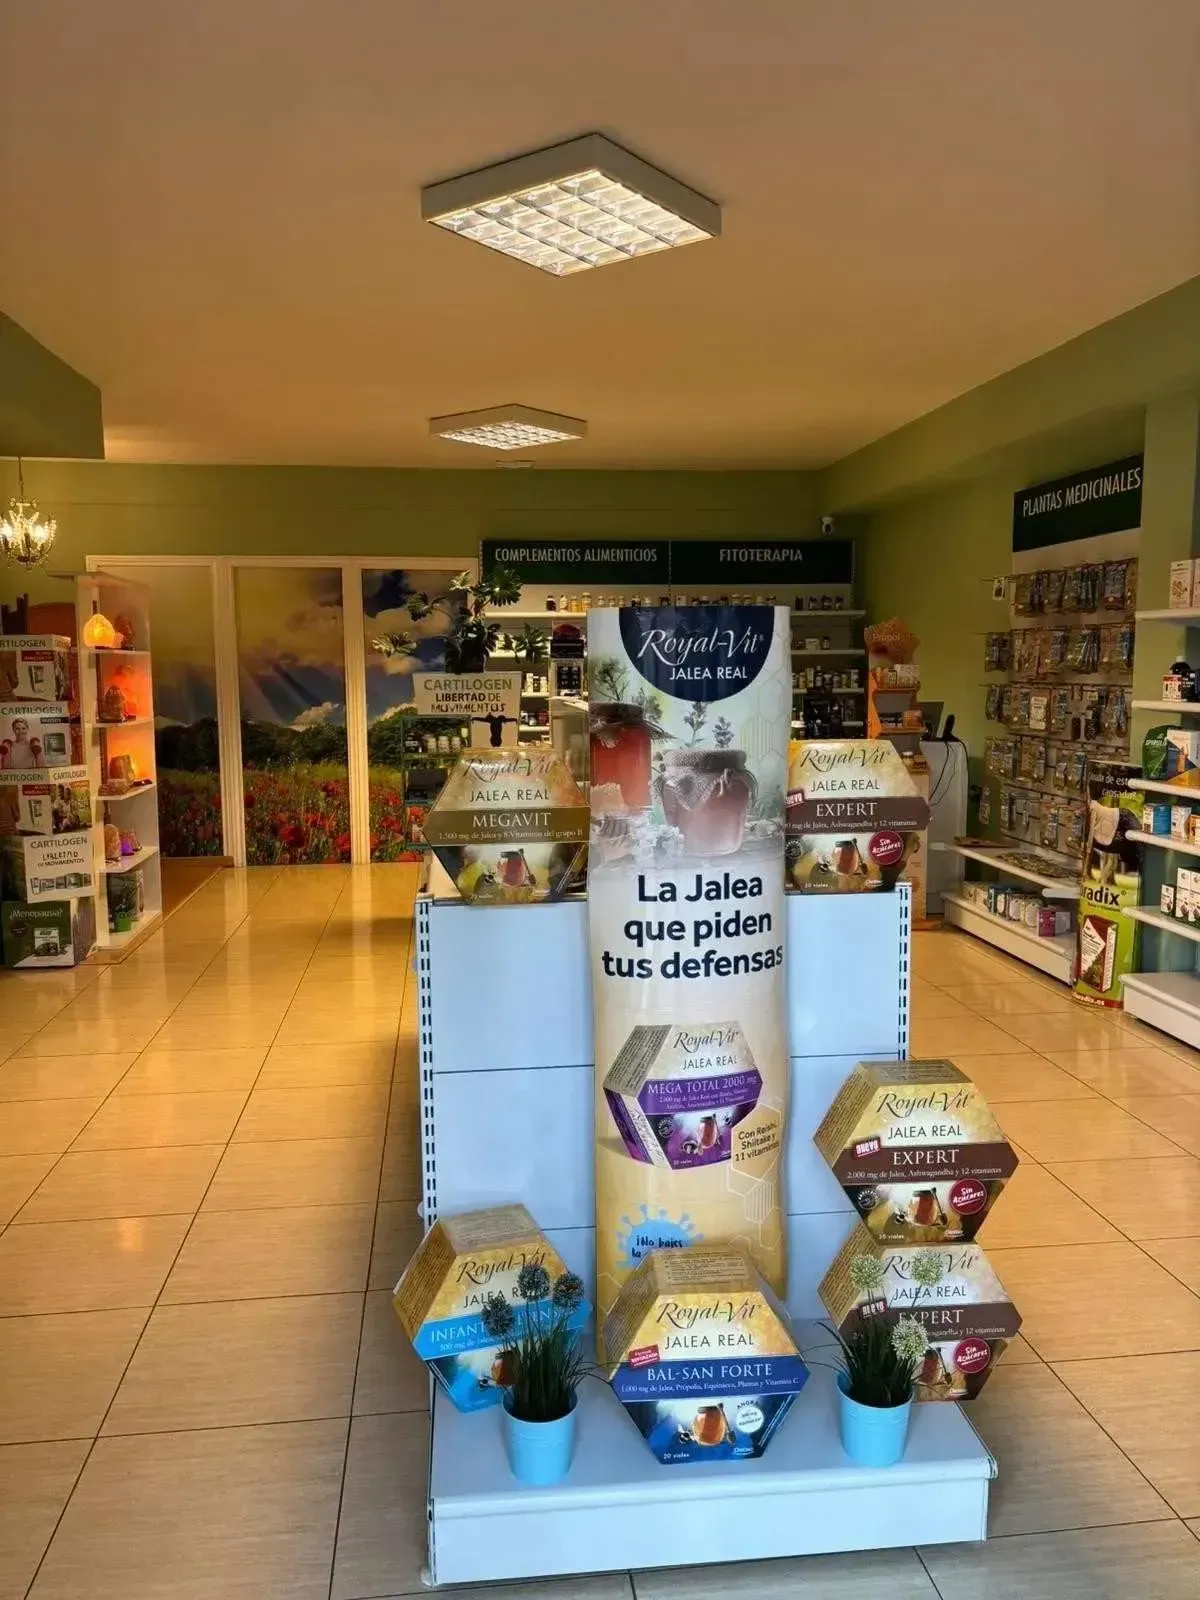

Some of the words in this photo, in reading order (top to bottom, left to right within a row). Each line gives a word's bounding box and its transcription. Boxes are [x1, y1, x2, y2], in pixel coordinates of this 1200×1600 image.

[1022, 489, 1063, 518] PLANTAS
[1065, 467, 1142, 506] MEDICINALES
[494, 547, 582, 563] COMPLEMENTOS
[584, 547, 658, 563] ALIMENTICIOS
[718, 548, 804, 563] FITOTERAPIA
[669, 666, 713, 682] JALEA
[716, 665, 749, 681] REAL
[423, 677, 513, 692] CARTILOGEN
[435, 692, 486, 703] LIBERTAD
[487, 692, 501, 703] DE
[1, 706, 63, 716] CARTILOGEN
[430, 702, 506, 714] MOVIMIENTOS
[810, 779, 848, 792] JALEA
[851, 778, 881, 791] REAL
[470, 790, 511, 803] JALEA
[516, 788, 550, 801] REAL
[815, 802, 879, 818] EXPERT
[472, 812, 552, 829] MEGAVIT
[30, 837, 88, 849] CARTILOGEN
[638, 874, 677, 903] La
[684, 872, 764, 903] Jalea
[623, 918, 686, 948] que
[693, 909, 772, 947] piden
[602, 949, 653, 980] tus
[660, 944, 784, 980] defensas
[682, 1055, 713, 1071] JALEA
[647, 1083, 683, 1095] MEGA
[686, 1079, 721, 1094] TOTAL
[721, 1075, 746, 1089] 2000
[737, 1129, 756, 1141] Con
[887, 1126, 926, 1140] JALEA
[932, 1124, 963, 1138] REAL
[892, 1149, 960, 1166] EXPERT
[866, 1171, 878, 1180] mg
[879, 1169, 888, 1178] de
[909, 1167, 954, 1178] Ashwagandha
[961, 1167, 970, 1175] 12
[961, 1187, 973, 1196] Sin
[894, 1287, 931, 1301] JALEA
[936, 1285, 968, 1298] REAL
[431, 1321, 486, 1343] INFANT
[965, 1327, 974, 1335] 12
[664, 1336, 711, 1350] JALEA
[717, 1333, 755, 1347] REAL
[965, 1346, 977, 1355] Sin
[647, 1367, 714, 1382] BAL-SAN
[720, 1363, 774, 1379] FORTE
[649, 1385, 658, 1393] de
